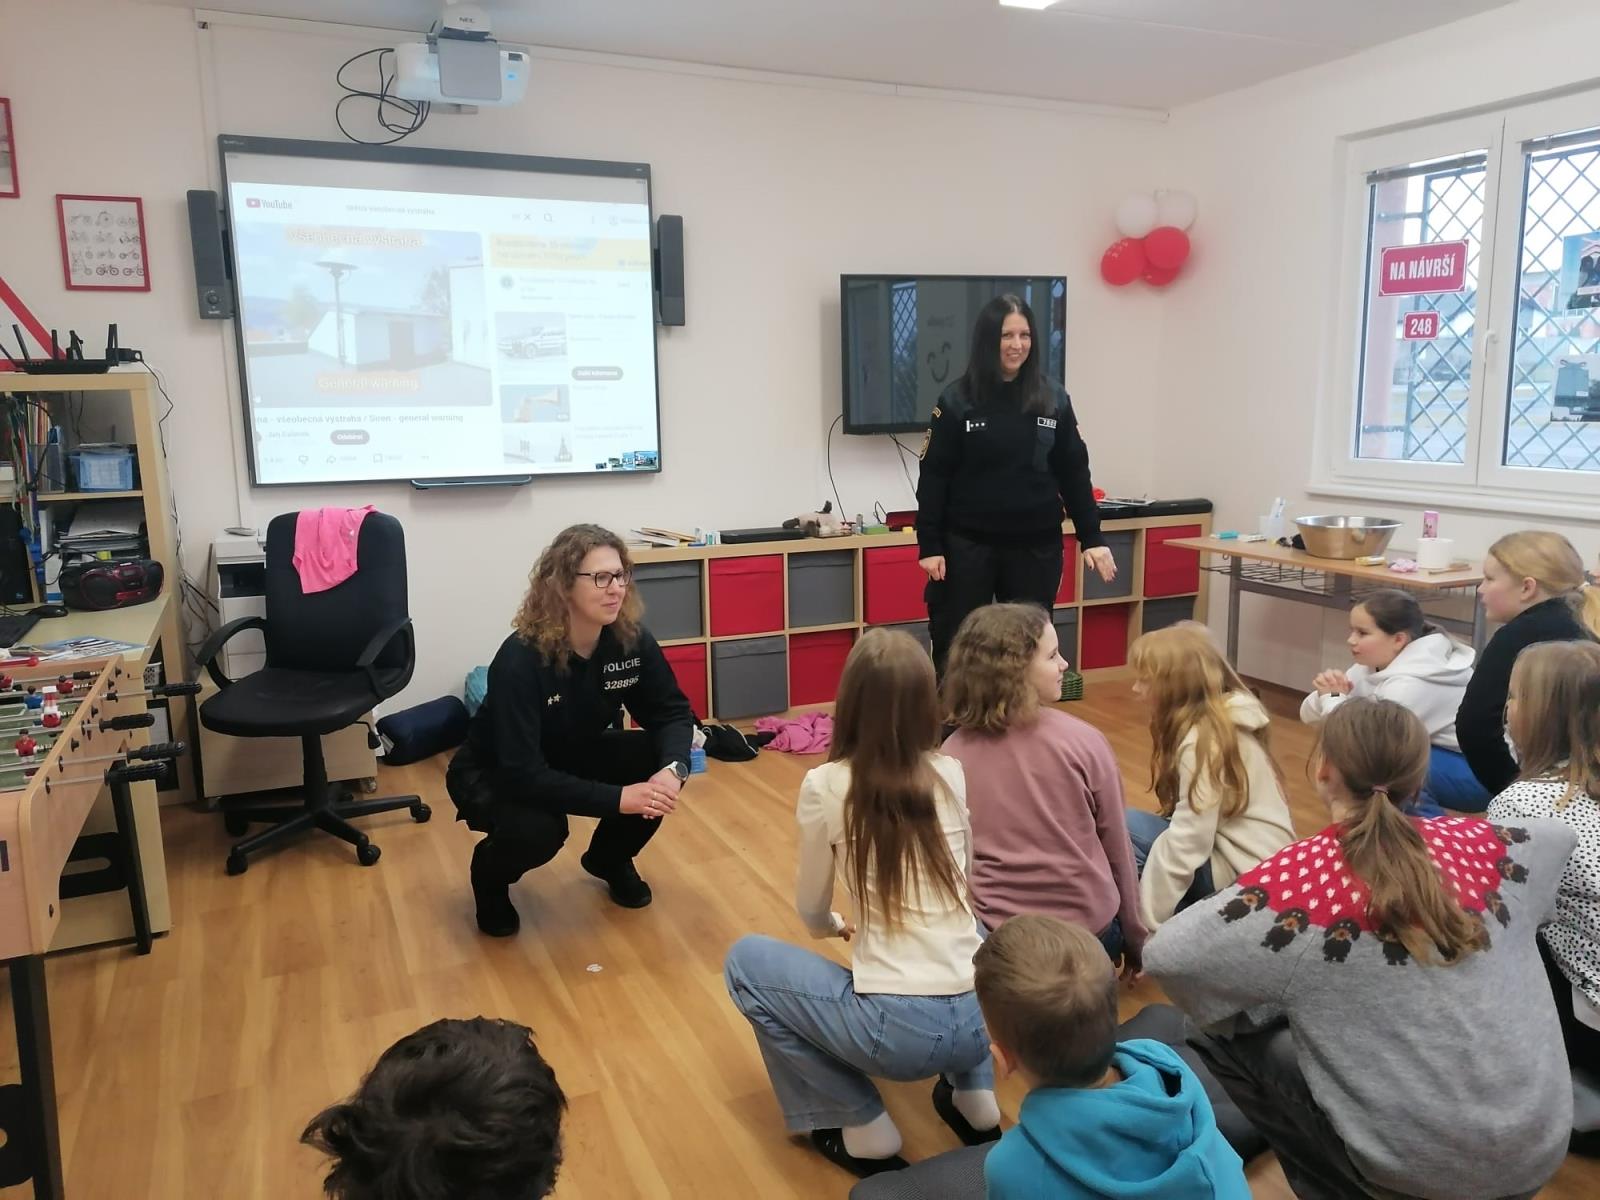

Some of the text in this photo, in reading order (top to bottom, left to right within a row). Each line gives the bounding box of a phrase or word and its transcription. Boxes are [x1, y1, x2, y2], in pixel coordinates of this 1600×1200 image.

[261, 199, 293, 210] YouTube
[1390, 253, 1456, 280] NA NÁVRŠÍ
[1410, 318, 1432, 335] 248
[399, 413, 429, 425] general
[603, 657, 641, 673] POLICIE
